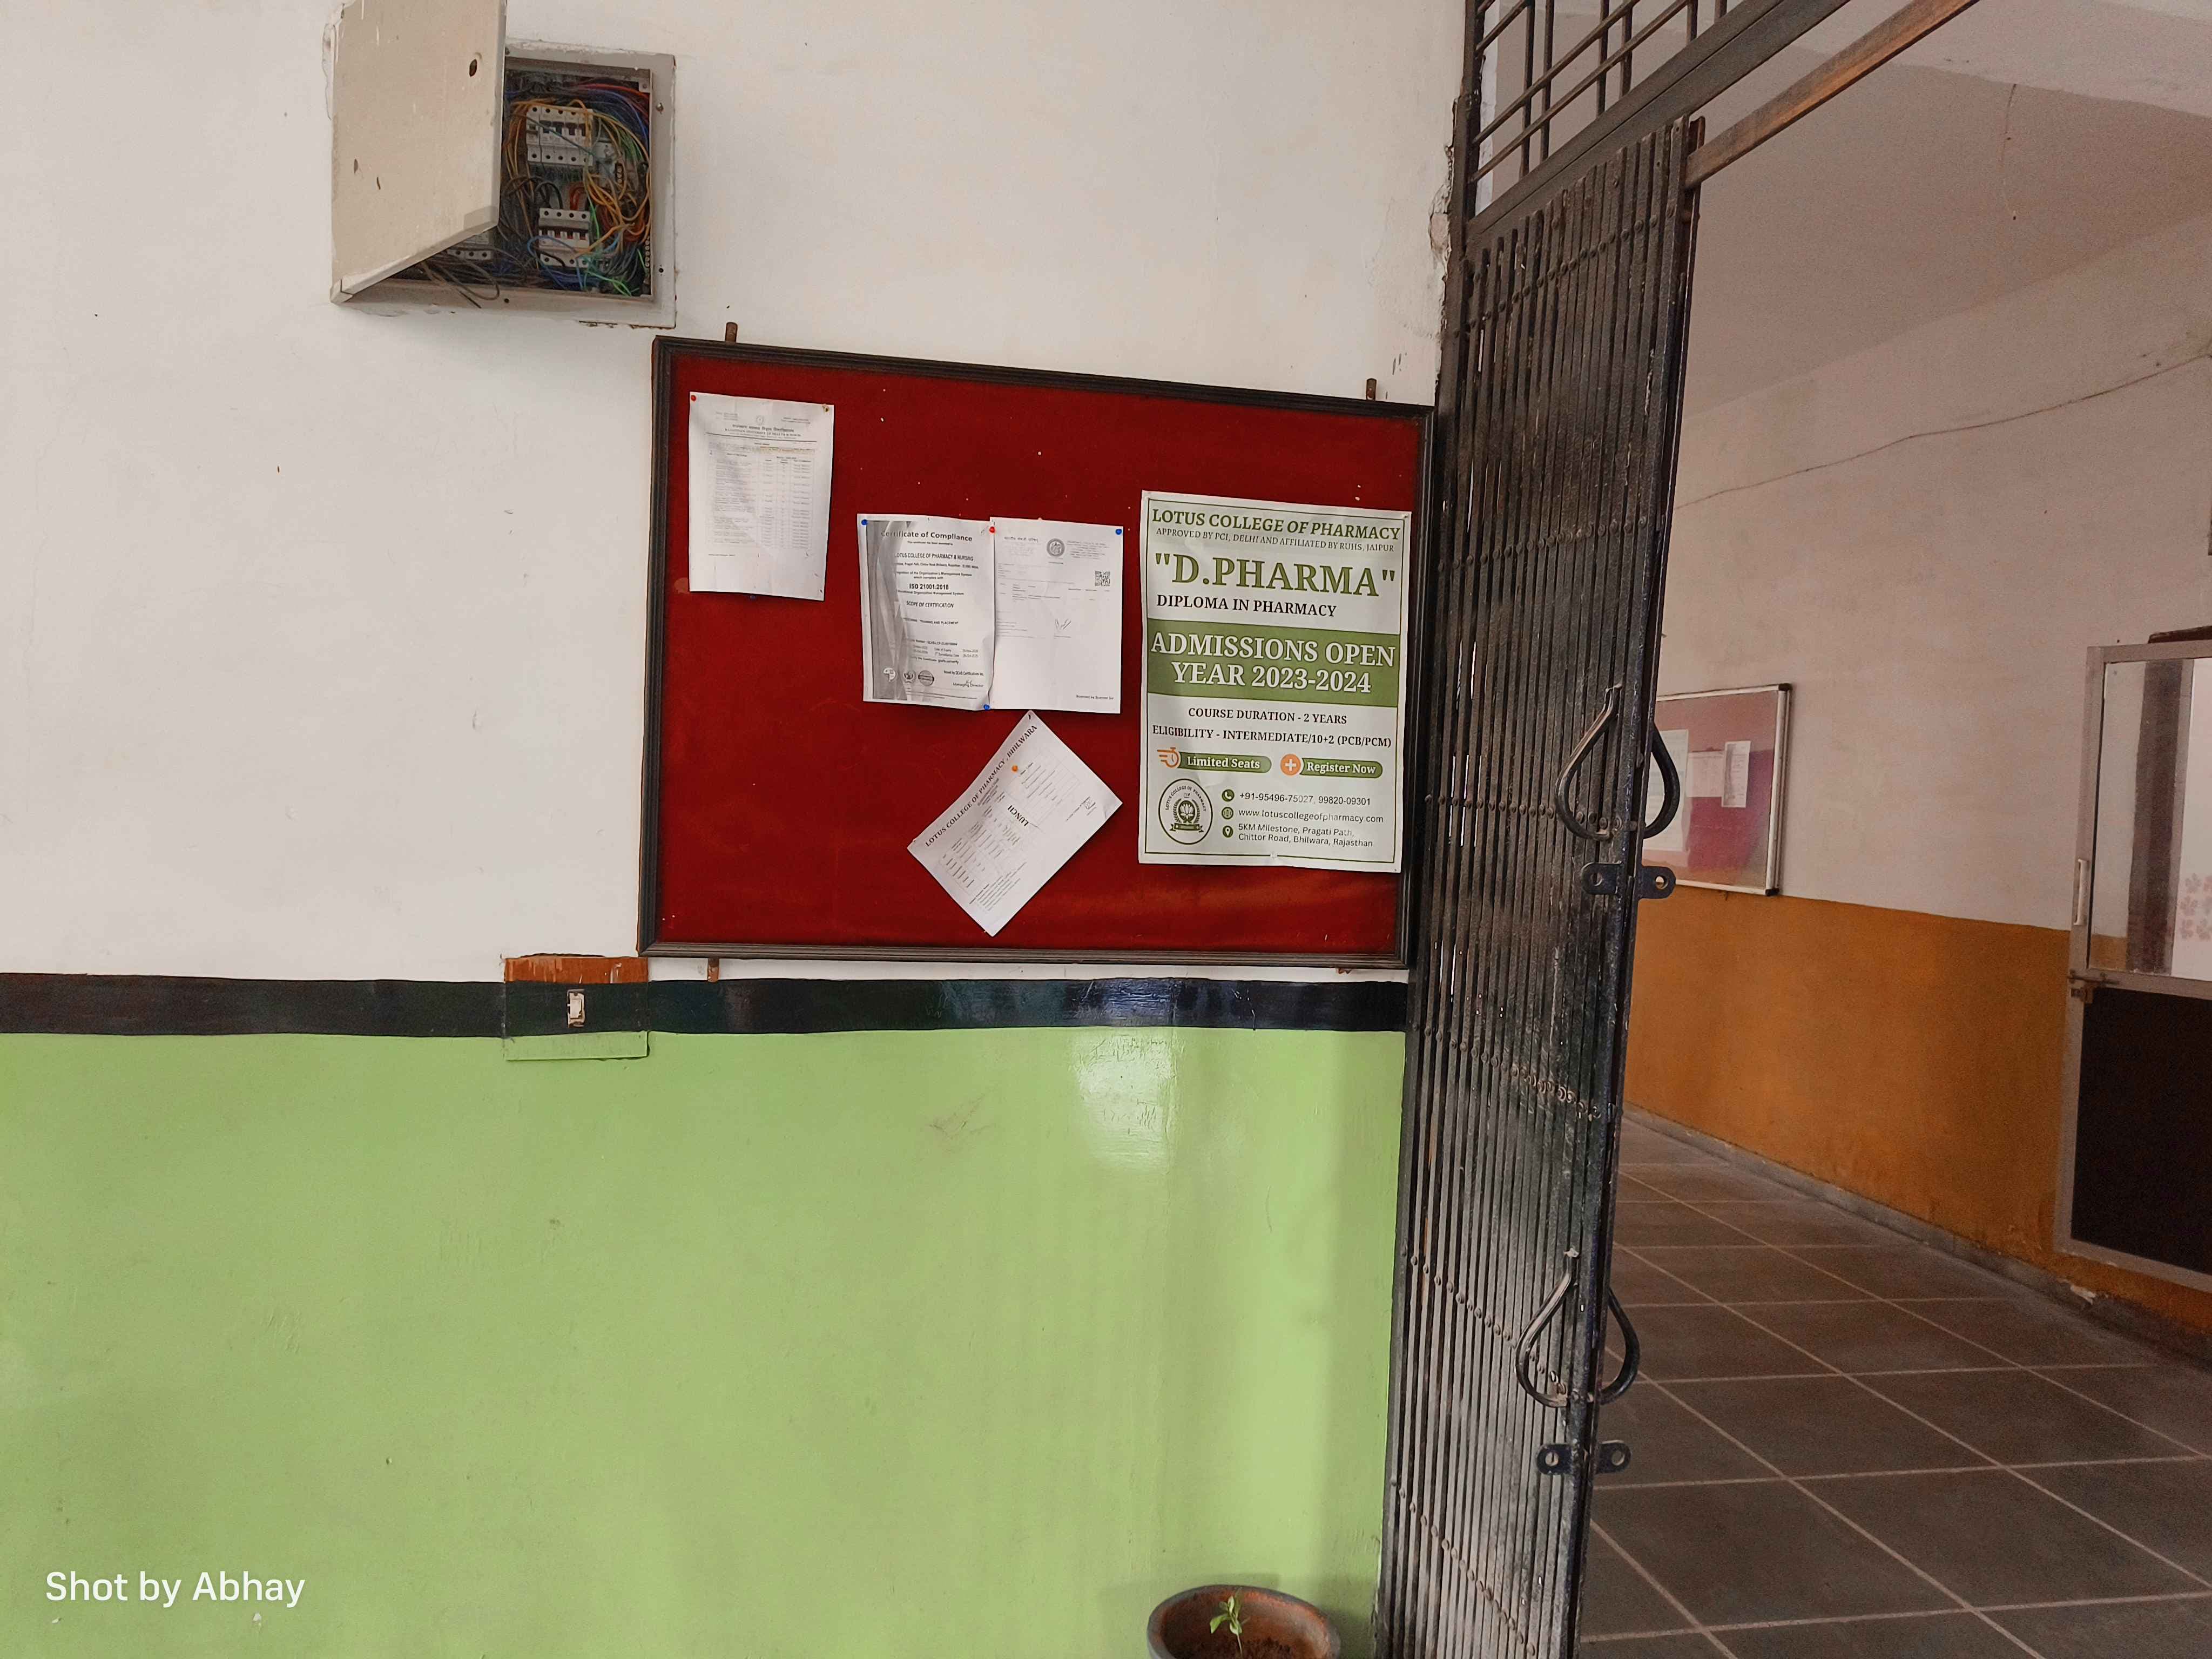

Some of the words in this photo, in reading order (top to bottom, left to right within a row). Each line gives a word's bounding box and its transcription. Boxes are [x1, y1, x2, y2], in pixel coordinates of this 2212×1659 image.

[1152, 509, 1205, 526] LOTUS
[1209, 514, 1284, 532] COLLEGE
[1287, 520, 1309, 534] OF
[1310, 522, 1400, 540] PHARMACY
[930, 532, 973, 542] Compliance
[1156, 528, 1201, 538] APPROVED
[1203, 531, 1213, 539] BY
[1215, 532, 1230, 542] PCI,
[1232, 534, 1259, 543] DELHI
[1260, 536, 1278, 545] AND
[1279, 537, 1326, 549] AFFILIATED
[1328, 541, 1338, 550] BY
[1366, 544, 1394, 552] JAIPUR
[1154, 552, 1396, 597] "D.PHARMA"
[1156, 594, 1229, 610] DIPLOMA
[1233, 598, 1250, 611] IN
[1253, 599, 1337, 617] PHARMACY
[1150, 631, 1319, 663] ADMISSIONS
[1325, 642, 1396, 667] OPEN
[1171, 661, 1245, 686] YEAR
[1251, 665, 1372, 694] 2023-2024
[1188, 707, 1233, 719] COURSE
[1236, 710, 1295, 722] DURATION
[1304, 713, 1310, 723] 2
[1312, 713, 1347, 725] YEARS
[1152, 724, 1214, 739] ELIGIBILITY
[1222, 730, 1334, 744] INTERMEDIATE/10+2
[1337, 735, 1392, 748] (PCB/PCM)
[1187, 756, 1229, 768] Limited
[1231, 758, 1260, 769] Seats
[1306, 761, 1351, 774] Register
[1352, 764, 1377, 774] Now
[925, 827, 947, 847] LOTUS
[946, 802, 973, 828] COLLEGE
[972, 792, 980, 804] OF
[978, 759, 1006, 794] PHARMACY
[1318, 795, 1370, 806] 99820-09301
[1007, 804, 1029, 827] LUNCH
[1238, 823, 1256, 831] 5KM
[1258, 824, 1300, 834] Milestone,
[1303, 826, 1331, 837] Pragati
[1268, 834, 1291, 844] Road,
[1293, 835, 1331, 846] Bhilwara,
[1333, 838, 1373, 847] Rajasthan
